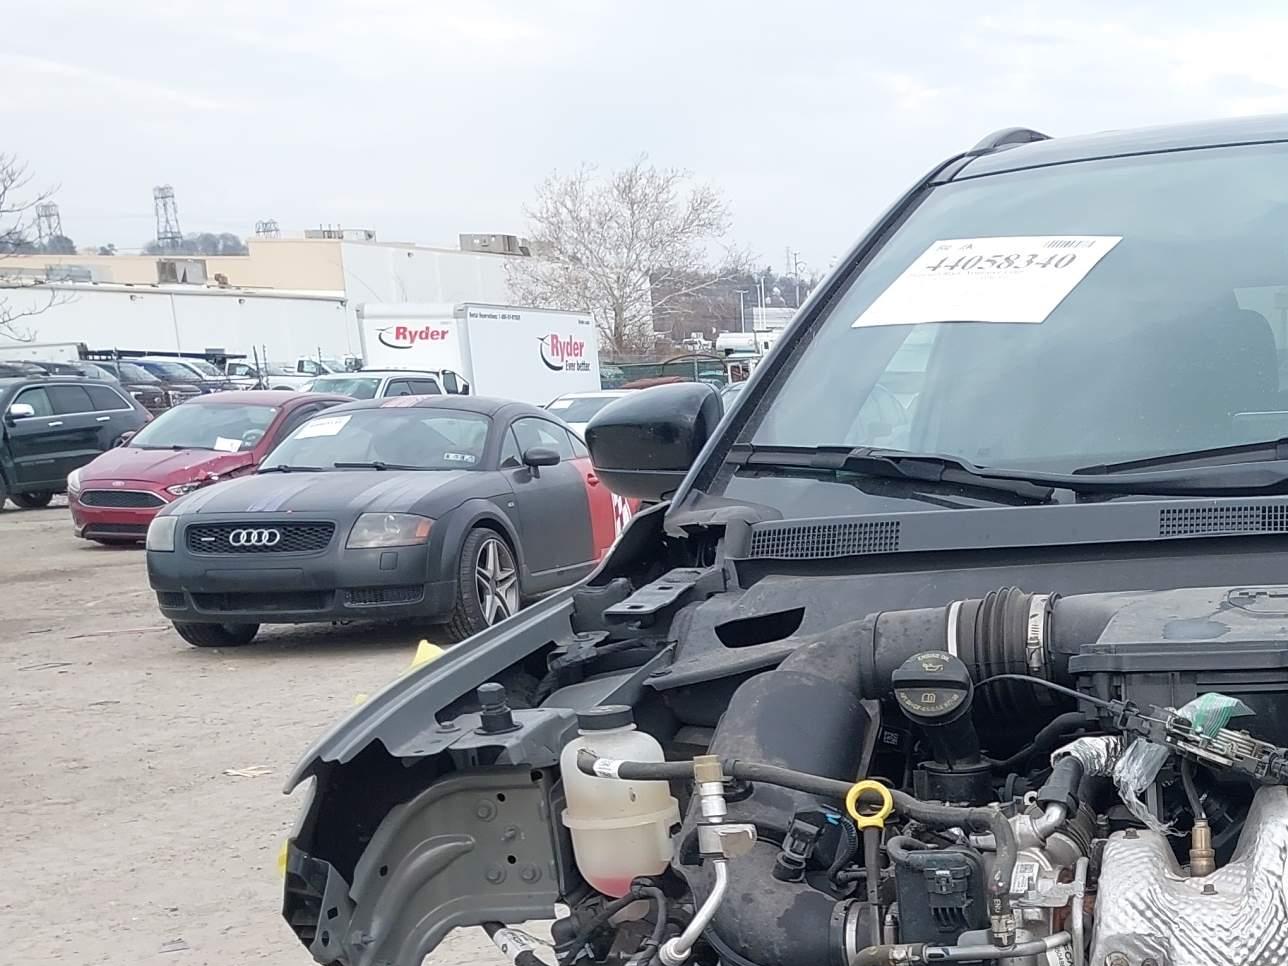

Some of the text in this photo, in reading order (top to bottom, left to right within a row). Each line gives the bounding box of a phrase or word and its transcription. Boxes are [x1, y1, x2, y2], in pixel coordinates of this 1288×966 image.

[926, 253, 1077, 272] 44058340
[395, 326, 449, 344] Ryder
[550, 334, 585, 362] Ryder
